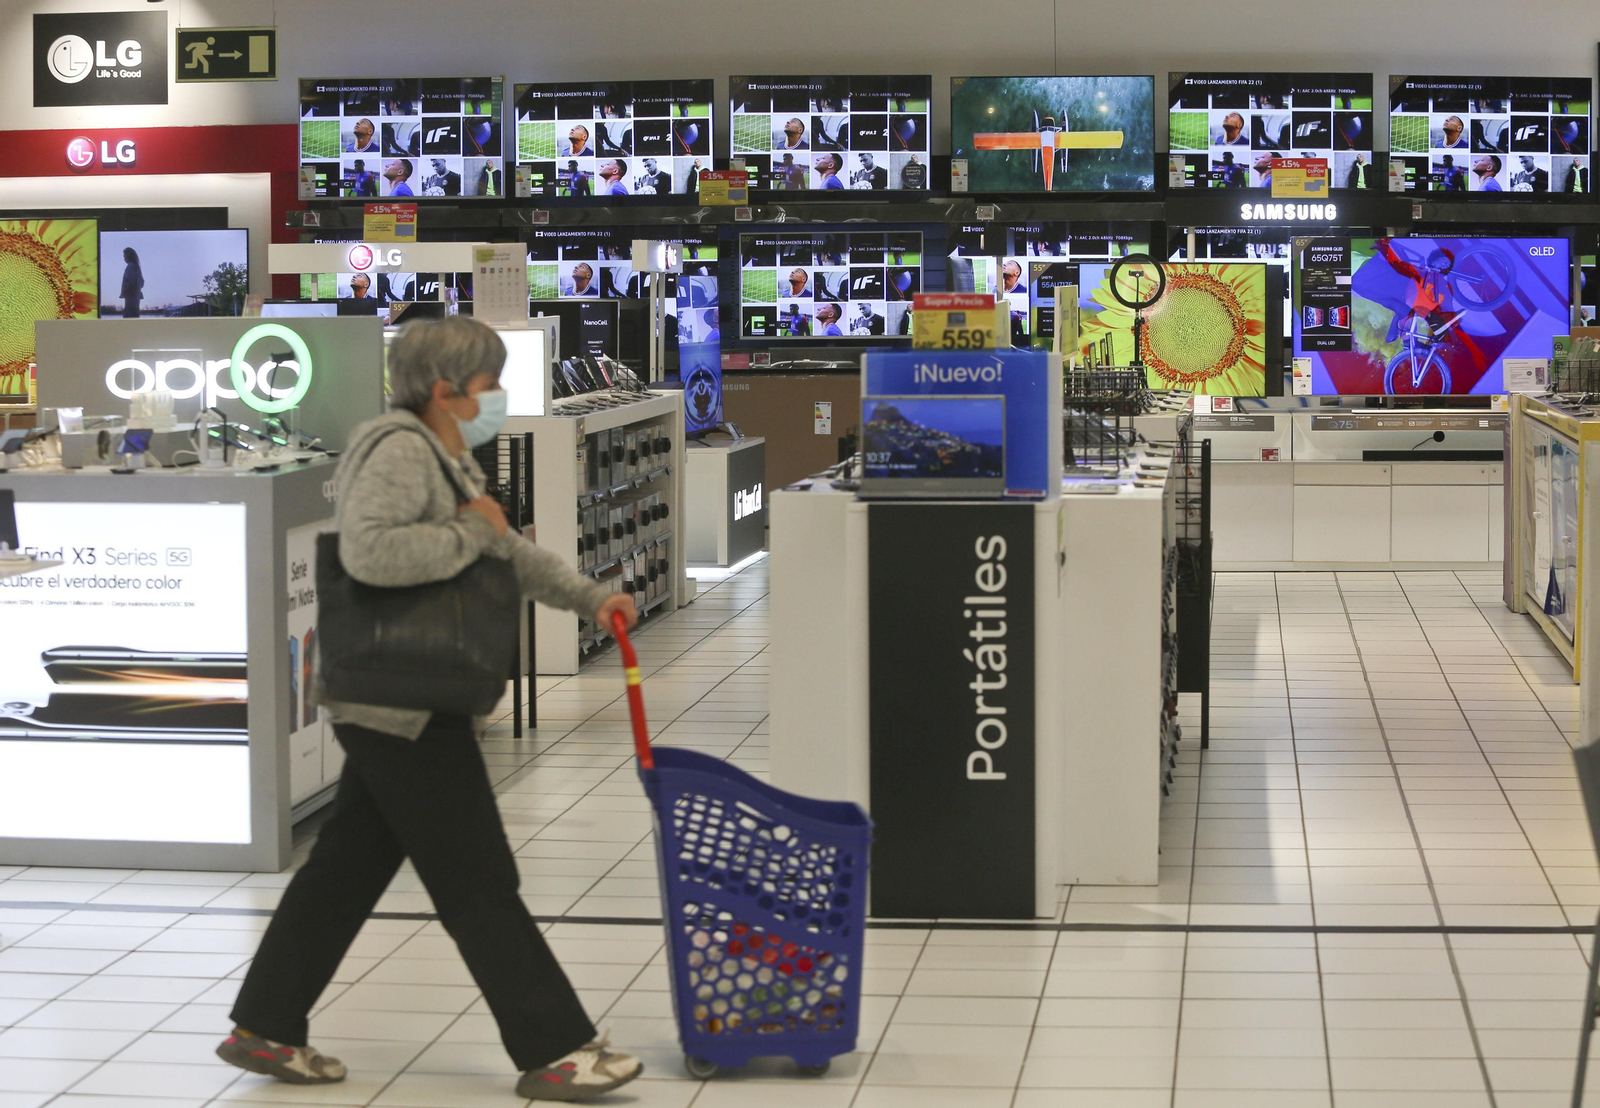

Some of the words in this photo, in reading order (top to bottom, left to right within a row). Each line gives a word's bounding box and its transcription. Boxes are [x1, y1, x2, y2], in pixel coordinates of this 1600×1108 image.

[96, 39, 142, 67] LG
[119, 69, 142, 79] Good
[101, 140, 136, 164] LG
[1277, 160, 1300, 168] -15%
[704, 172, 724, 180] -15%
[369, 205, 391, 214] -15%
[1241, 203, 1337, 220] SAMSUNG
[1529, 246, 1555, 256] QLED
[376, 249, 402, 266] LG
[1311, 253, 1343, 262] 65Q75T
[1033, 264, 1046, 272] 55"
[924, 297, 952, 307] Super
[953, 297, 984, 306] Precio
[914, 363, 1002, 383] ¡Nuevo!
[722, 383, 750, 391] MSUNG
[1327, 420, 1360, 430] Q75T
[734, 490, 742, 522] LG
[72, 547, 97, 565] X3
[105, 548, 158, 566] Series
[169, 551, 188, 563] 5G
[0, 574, 43, 588] cubre
[48, 574, 60, 588] el
[64, 575, 141, 589] verdadero
[146, 576, 182, 590] color
[963, 535, 1007, 780] Portátiles
